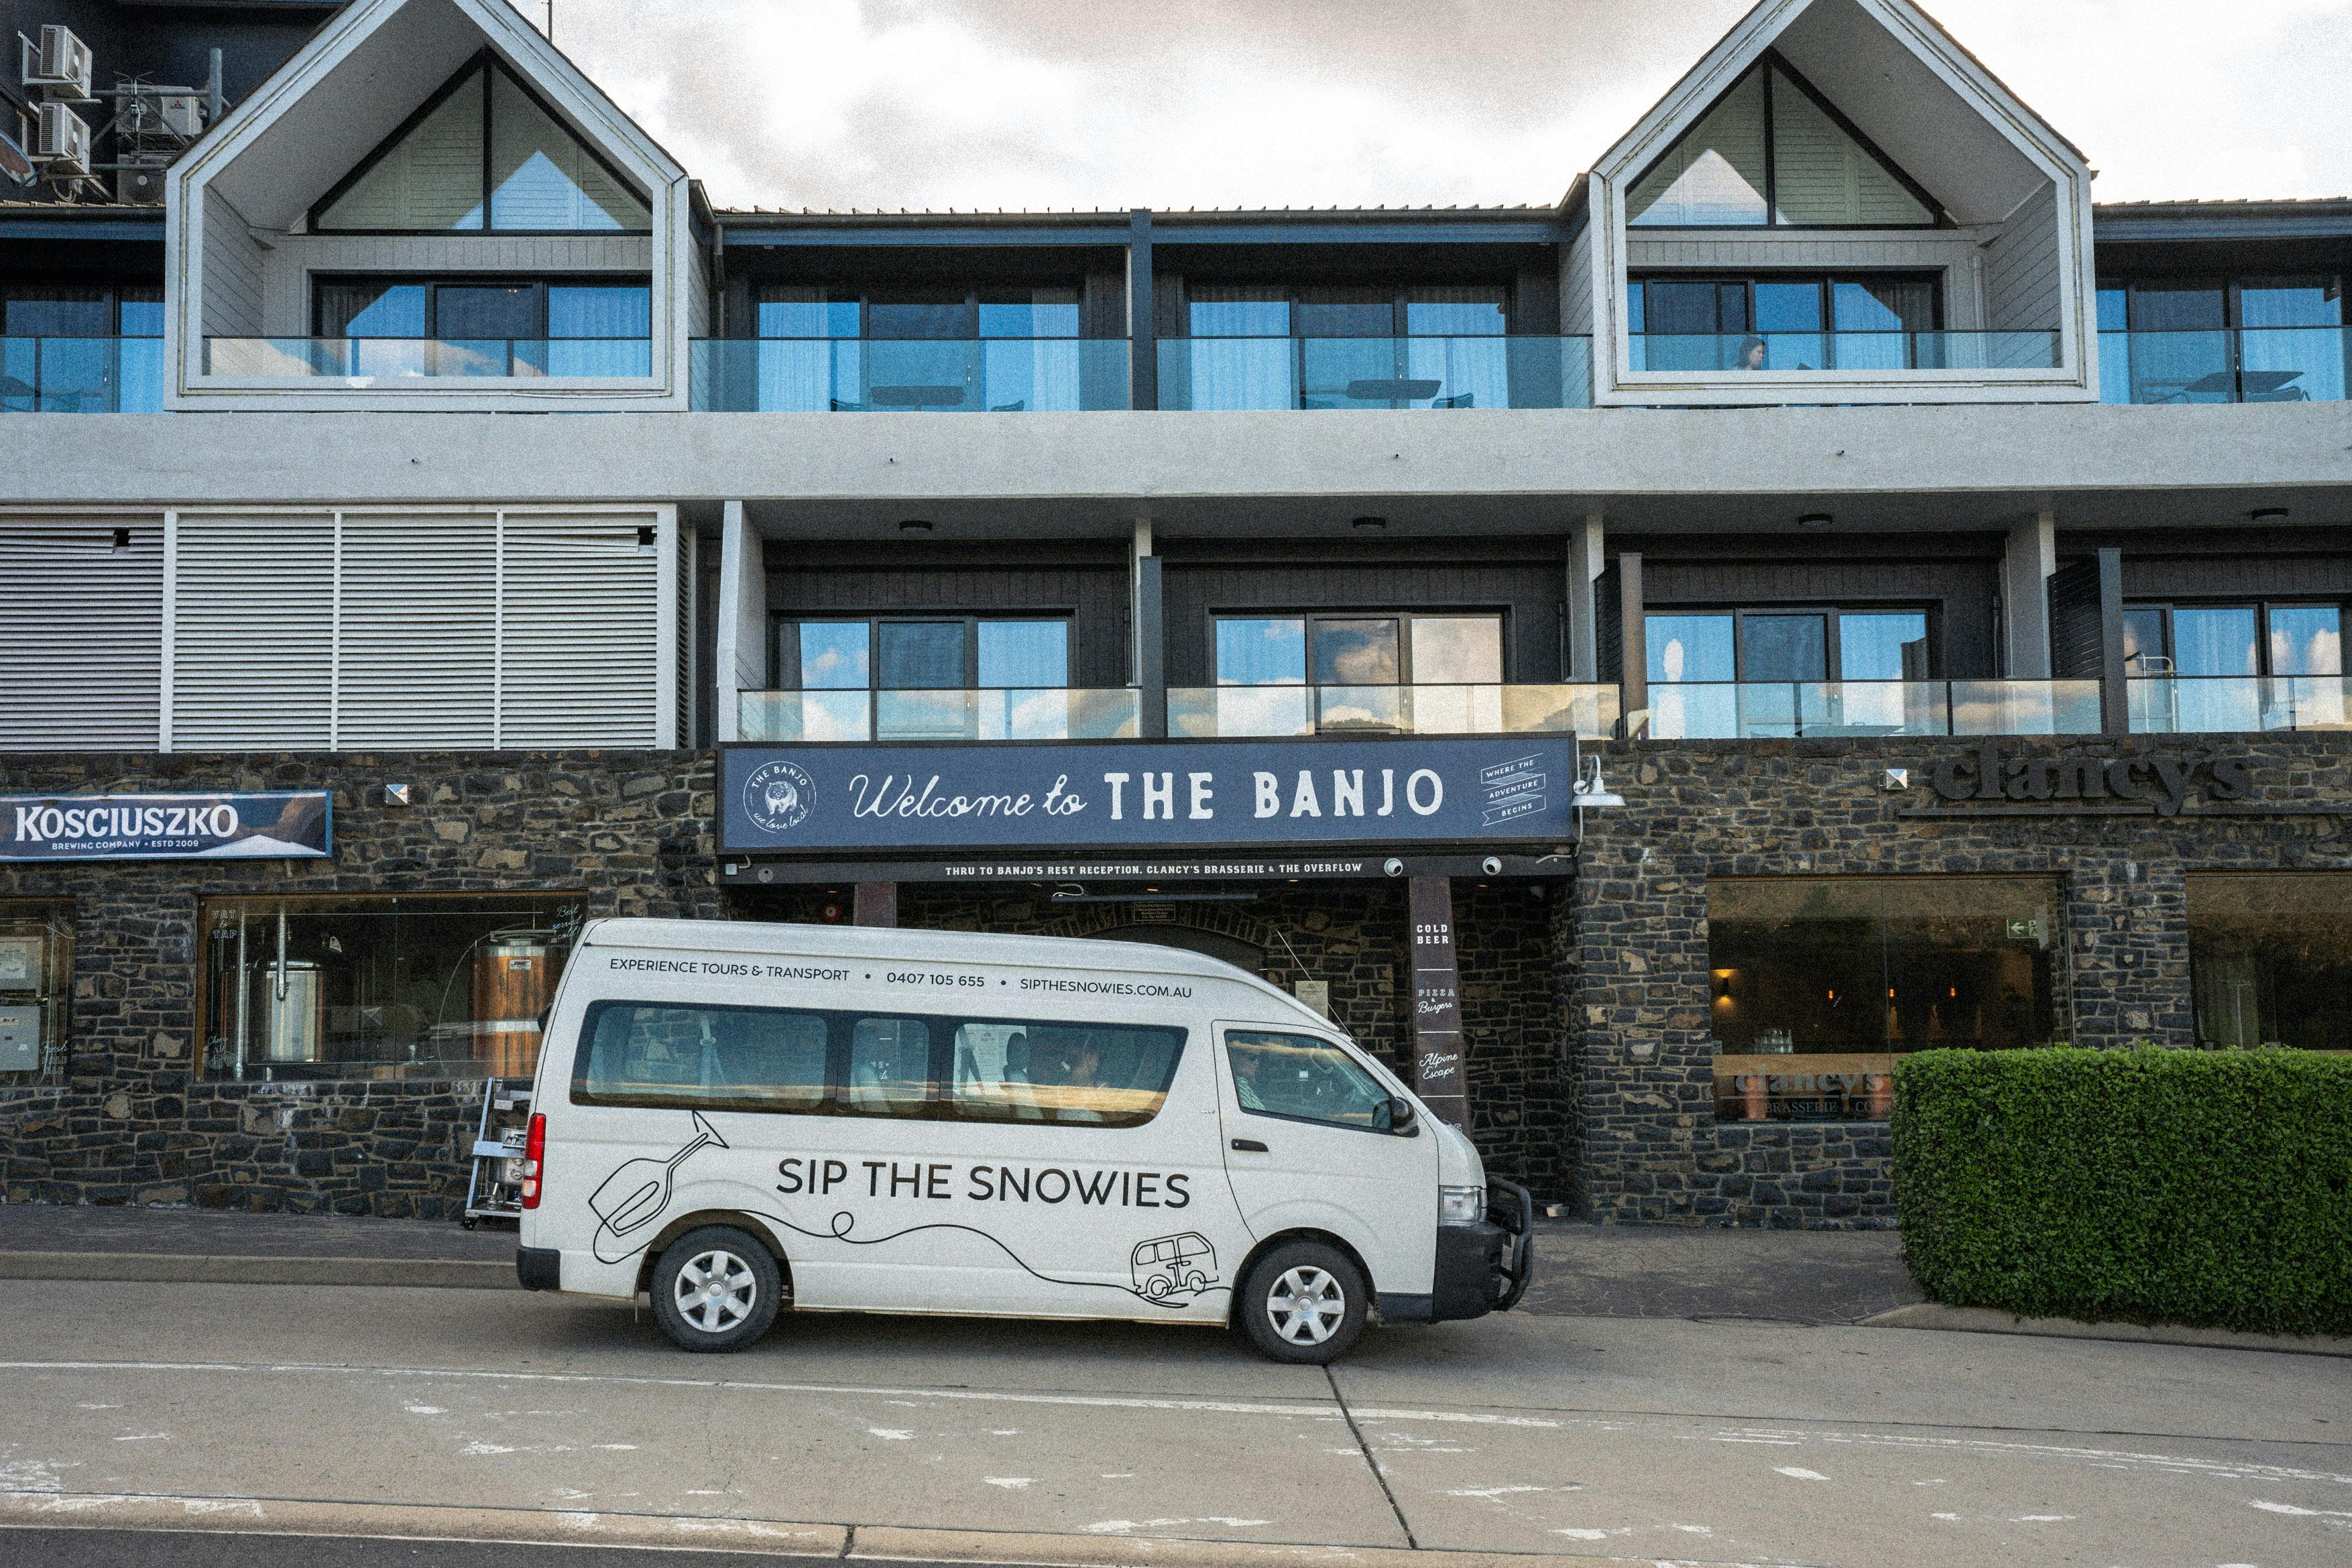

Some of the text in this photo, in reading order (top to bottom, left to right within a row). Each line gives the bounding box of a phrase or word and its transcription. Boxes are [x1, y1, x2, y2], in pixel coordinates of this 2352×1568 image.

[1486, 760, 1534, 778] WHERE THE
[752, 766, 807, 788] THE BANJO
[849, 768, 1444, 820] Welcome to THE BANJO
[1489, 780, 1538, 798] ADVENTURE
[754, 804, 808, 829] we love local
[1502, 803, 1532, 817] BEGINS
[15, 804, 239, 841] KOSCIUSZKO
[52, 842, 94, 850] BREWING
[95, 841, 141, 849] COMPANY
[980, 867, 992, 875] TO
[998, 867, 1043, 875] BANJO'S
[1047, 866, 1075, 875] REST
[1146, 865, 1199, 873] CLANCY'S
[1204, 865, 1264, 873] BRASSERIE
[1279, 864, 1299, 873] THE
[1304, 863, 1362, 872] OVERFLOW
[212, 910, 236, 918] VAT
[557, 904, 579, 917] Best
[213, 930, 237, 939] TAP
[1417, 924, 1448, 933] COLD
[1417, 936, 1449, 945] BEER
[610, 958, 1192, 998] EXPERIENCE TOURS & TRANSPORT 0407 105 655 SIPTHESNOWIES.COM.AU
[1418, 1001, 1453, 1014] Burgers
[1419, 1052, 1458, 1067] Alpine
[1423, 1066, 1455, 1079] Escape
[1735, 1065, 1884, 1100] clancy's
[1765, 1102, 1837, 1113] BRASSERIE
[776, 1158, 1190, 1209] SIP THE SNOWIES
